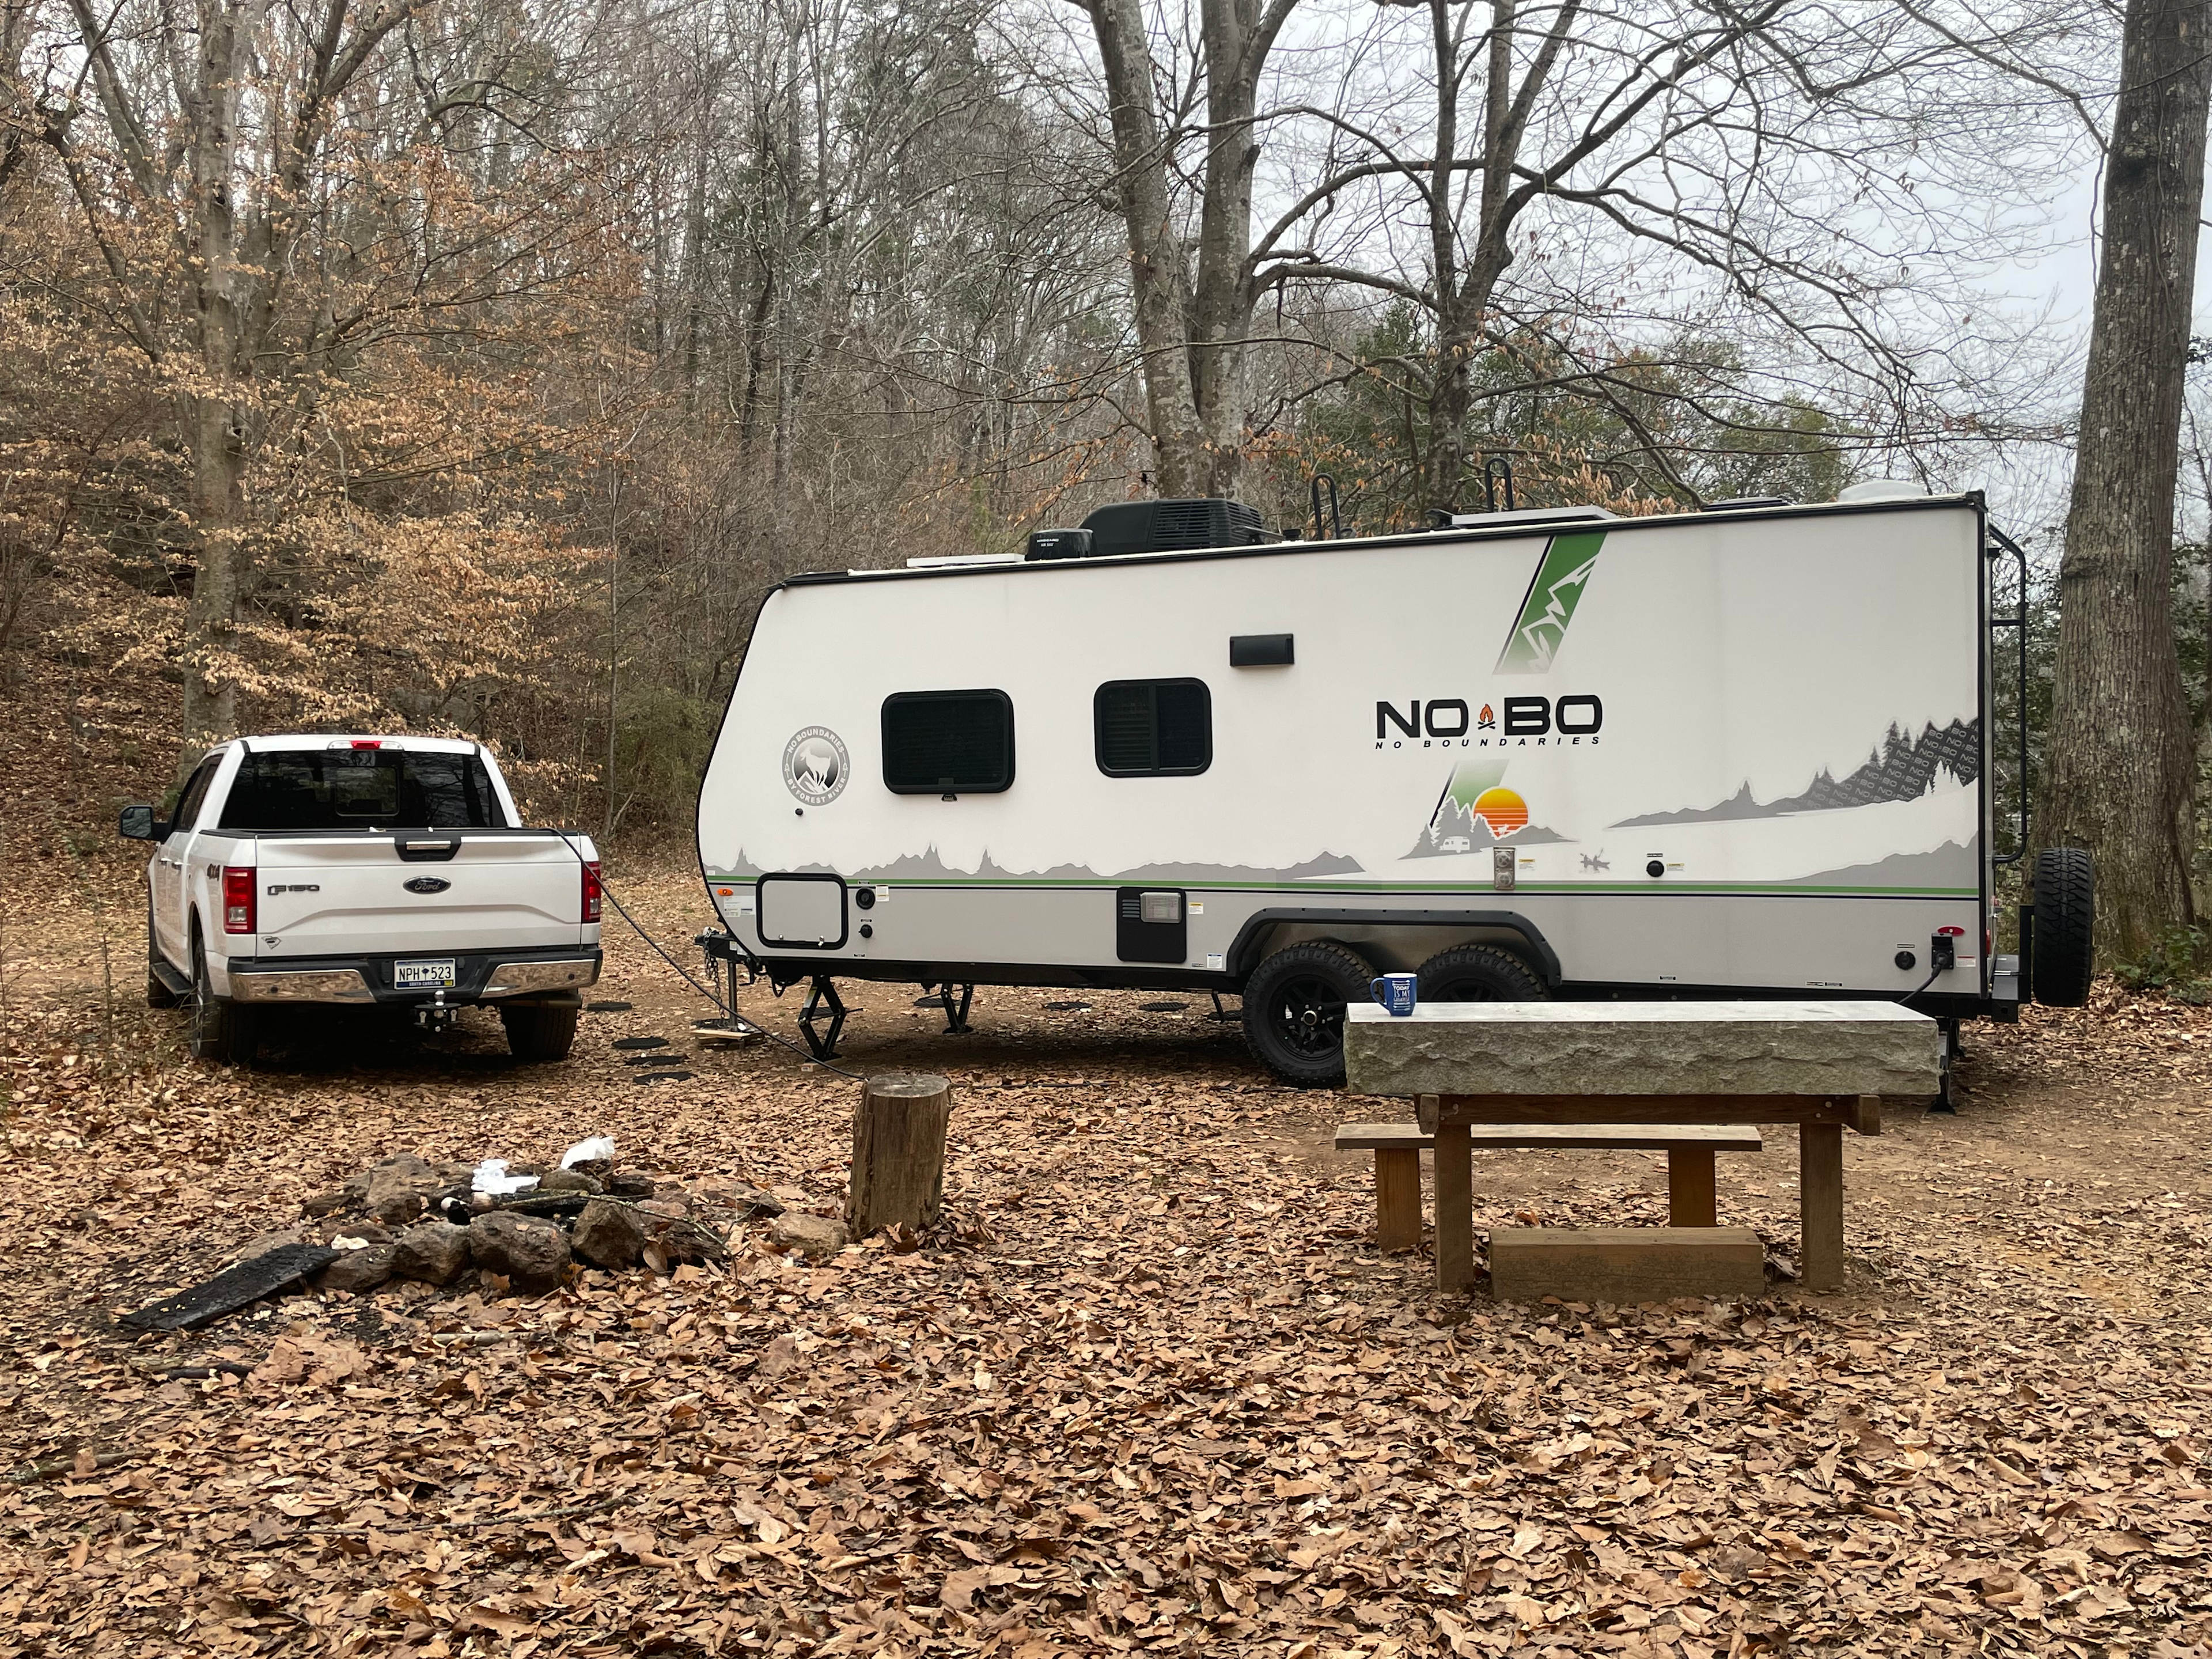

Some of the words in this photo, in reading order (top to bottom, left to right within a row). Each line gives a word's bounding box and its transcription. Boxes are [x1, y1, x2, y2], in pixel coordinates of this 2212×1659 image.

[1377, 699, 1468, 738] NO
[1504, 695, 1603, 736] BO
[787, 740, 797, 753] NO
[796, 728, 844, 752] BOUNDARIES
[1375, 741, 1402, 749] NO
[1423, 736, 1600, 748] BOUNDARIES
[1946, 737, 1961, 747] NO
[1923, 738, 1938, 748] NO
[1960, 753, 1976, 764] NO
[1919, 748, 1934, 757] NO
[1956, 763, 1971, 773] NO
[1887, 768, 1902, 778] NO
[1910, 766, 1925, 777] NO
[787, 779, 796, 790] BY
[796, 789, 825, 804] FOREST
[828, 778, 846, 799] RIVER
[414, 880, 441, 891] Ford
[399, 968, 419, 981] NPH
[431, 967, 451, 979] 523
